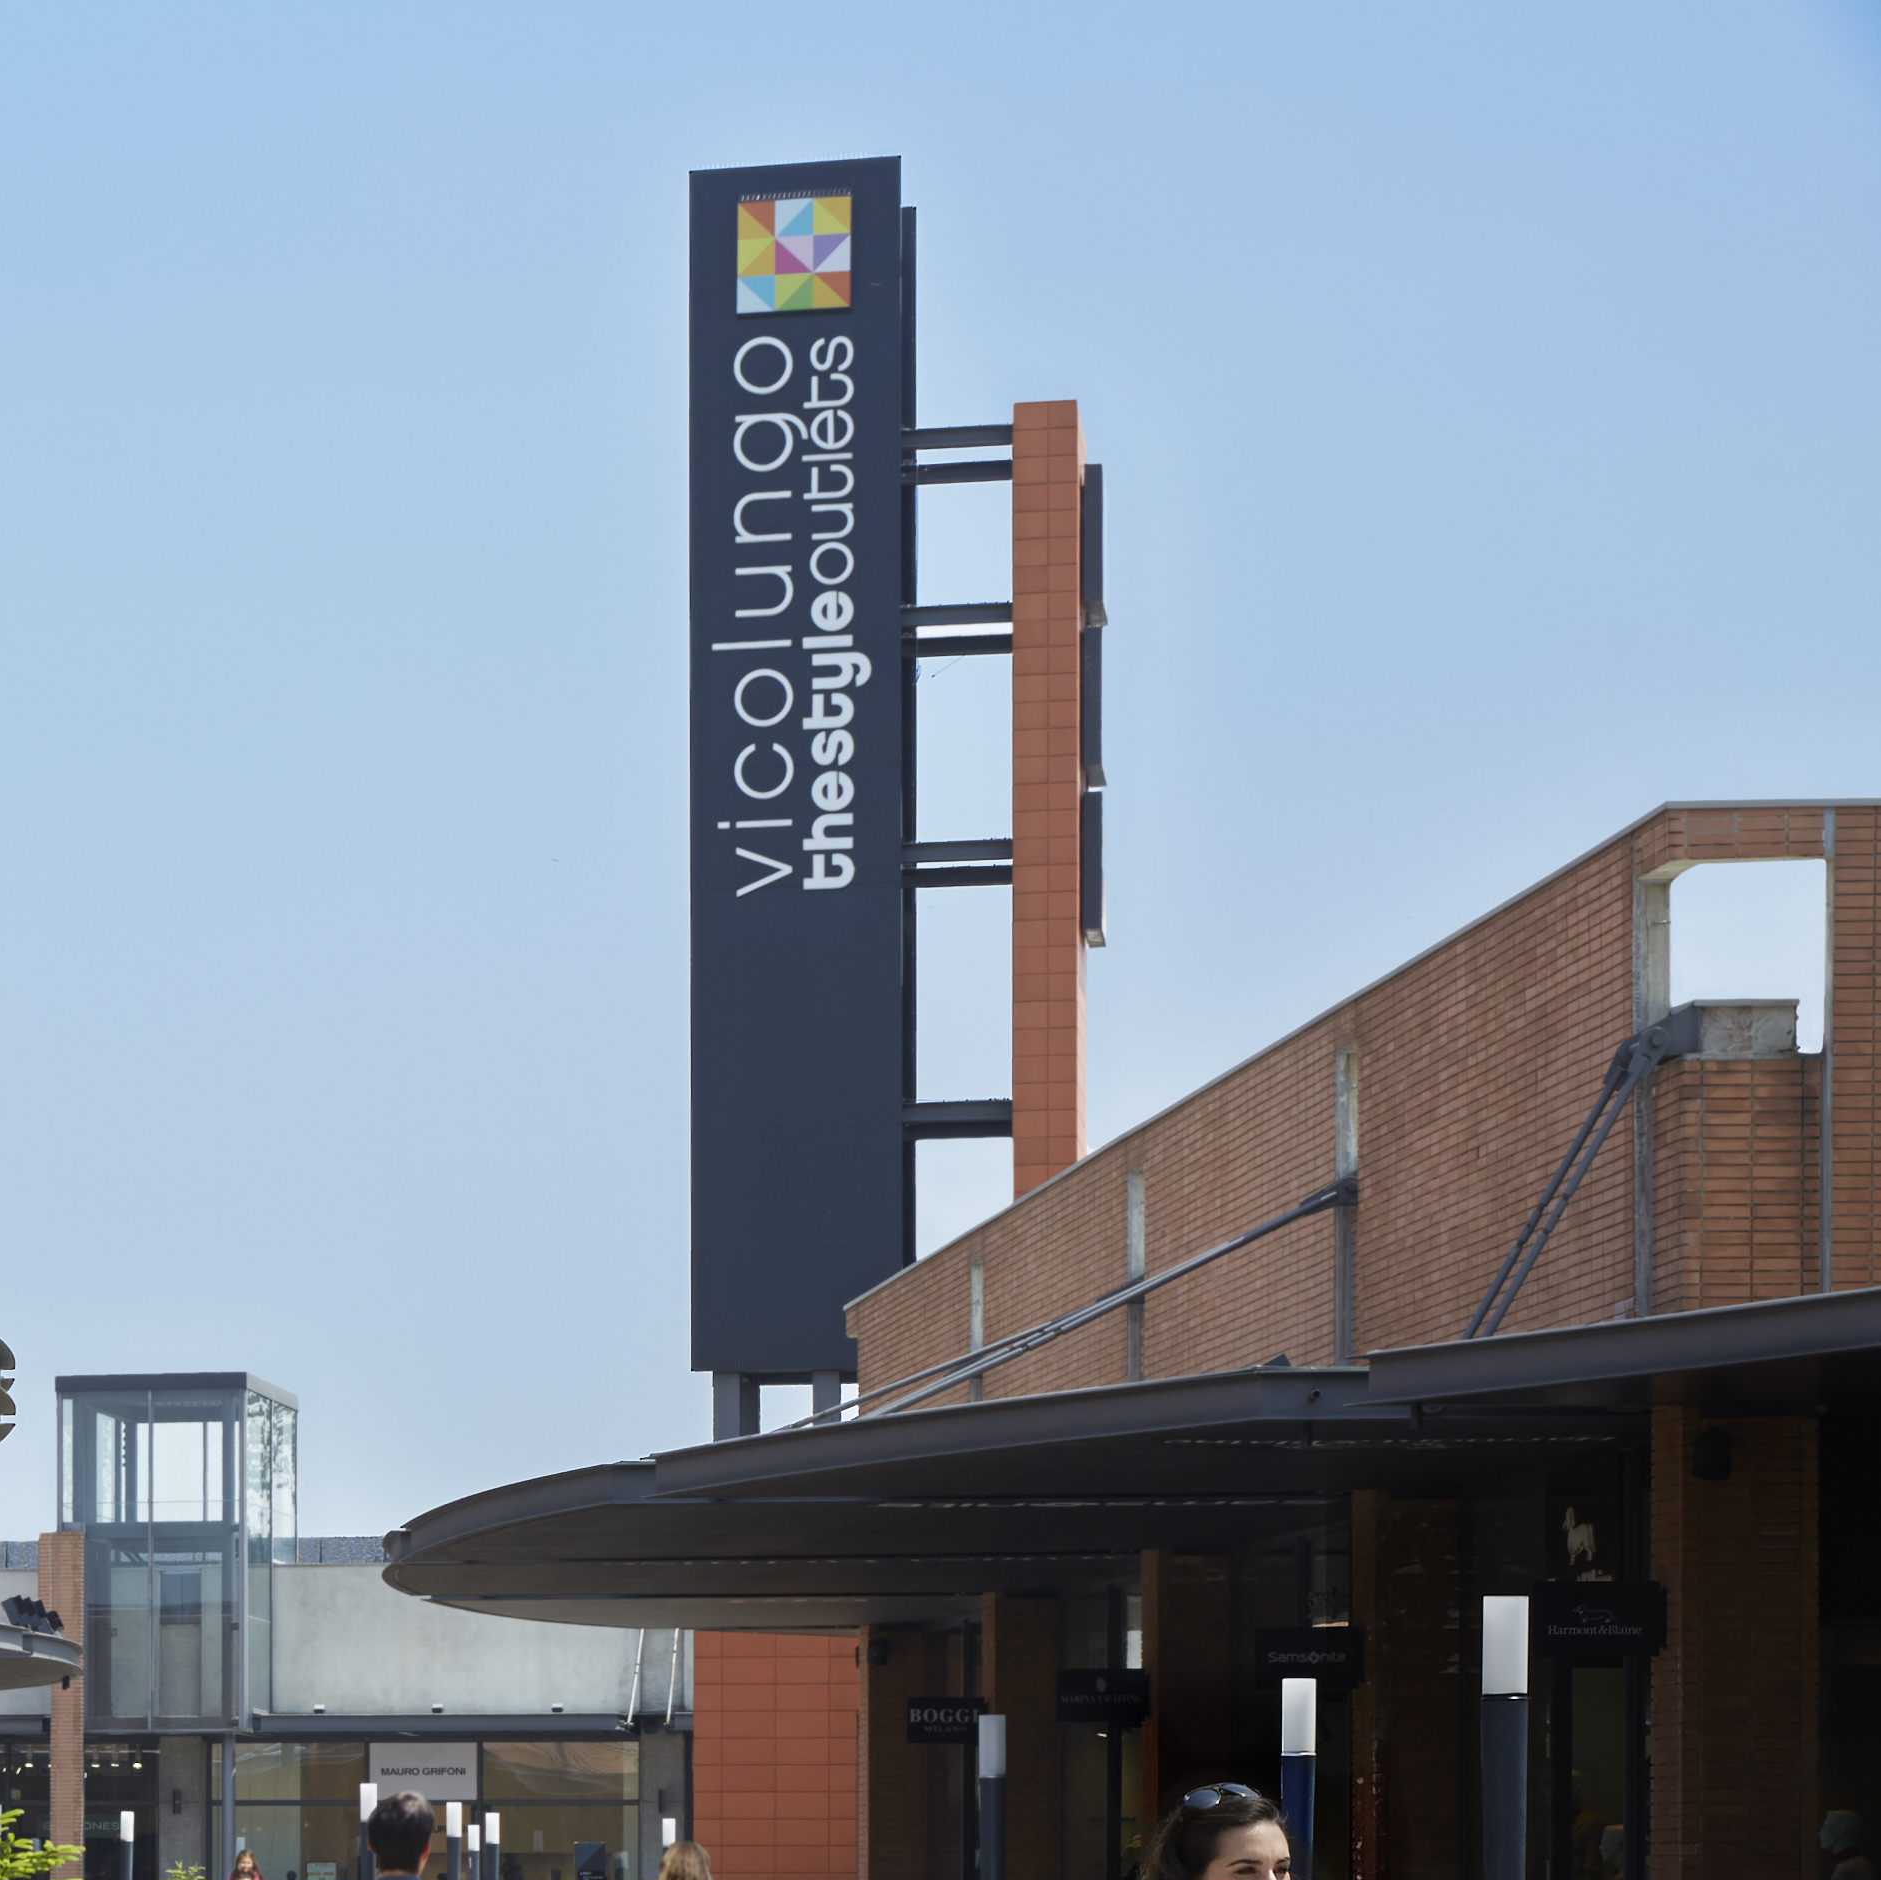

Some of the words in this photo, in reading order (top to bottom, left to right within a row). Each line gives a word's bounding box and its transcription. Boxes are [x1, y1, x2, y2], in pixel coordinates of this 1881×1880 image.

[712, 335, 809, 898] vicolungo
[1547, 1624, 1643, 1635] Harmont&Blaine
[1267, 1651, 1346, 1664] Samsonite
[1061, 1694, 1096, 1703] MARINA
[1097, 1694, 1143, 1703] YACHTING
[909, 1708, 979, 1723] BOGGI
[381, 1767, 420, 1776] MAURO
[422, 1767, 466, 1775] GRIFONI
